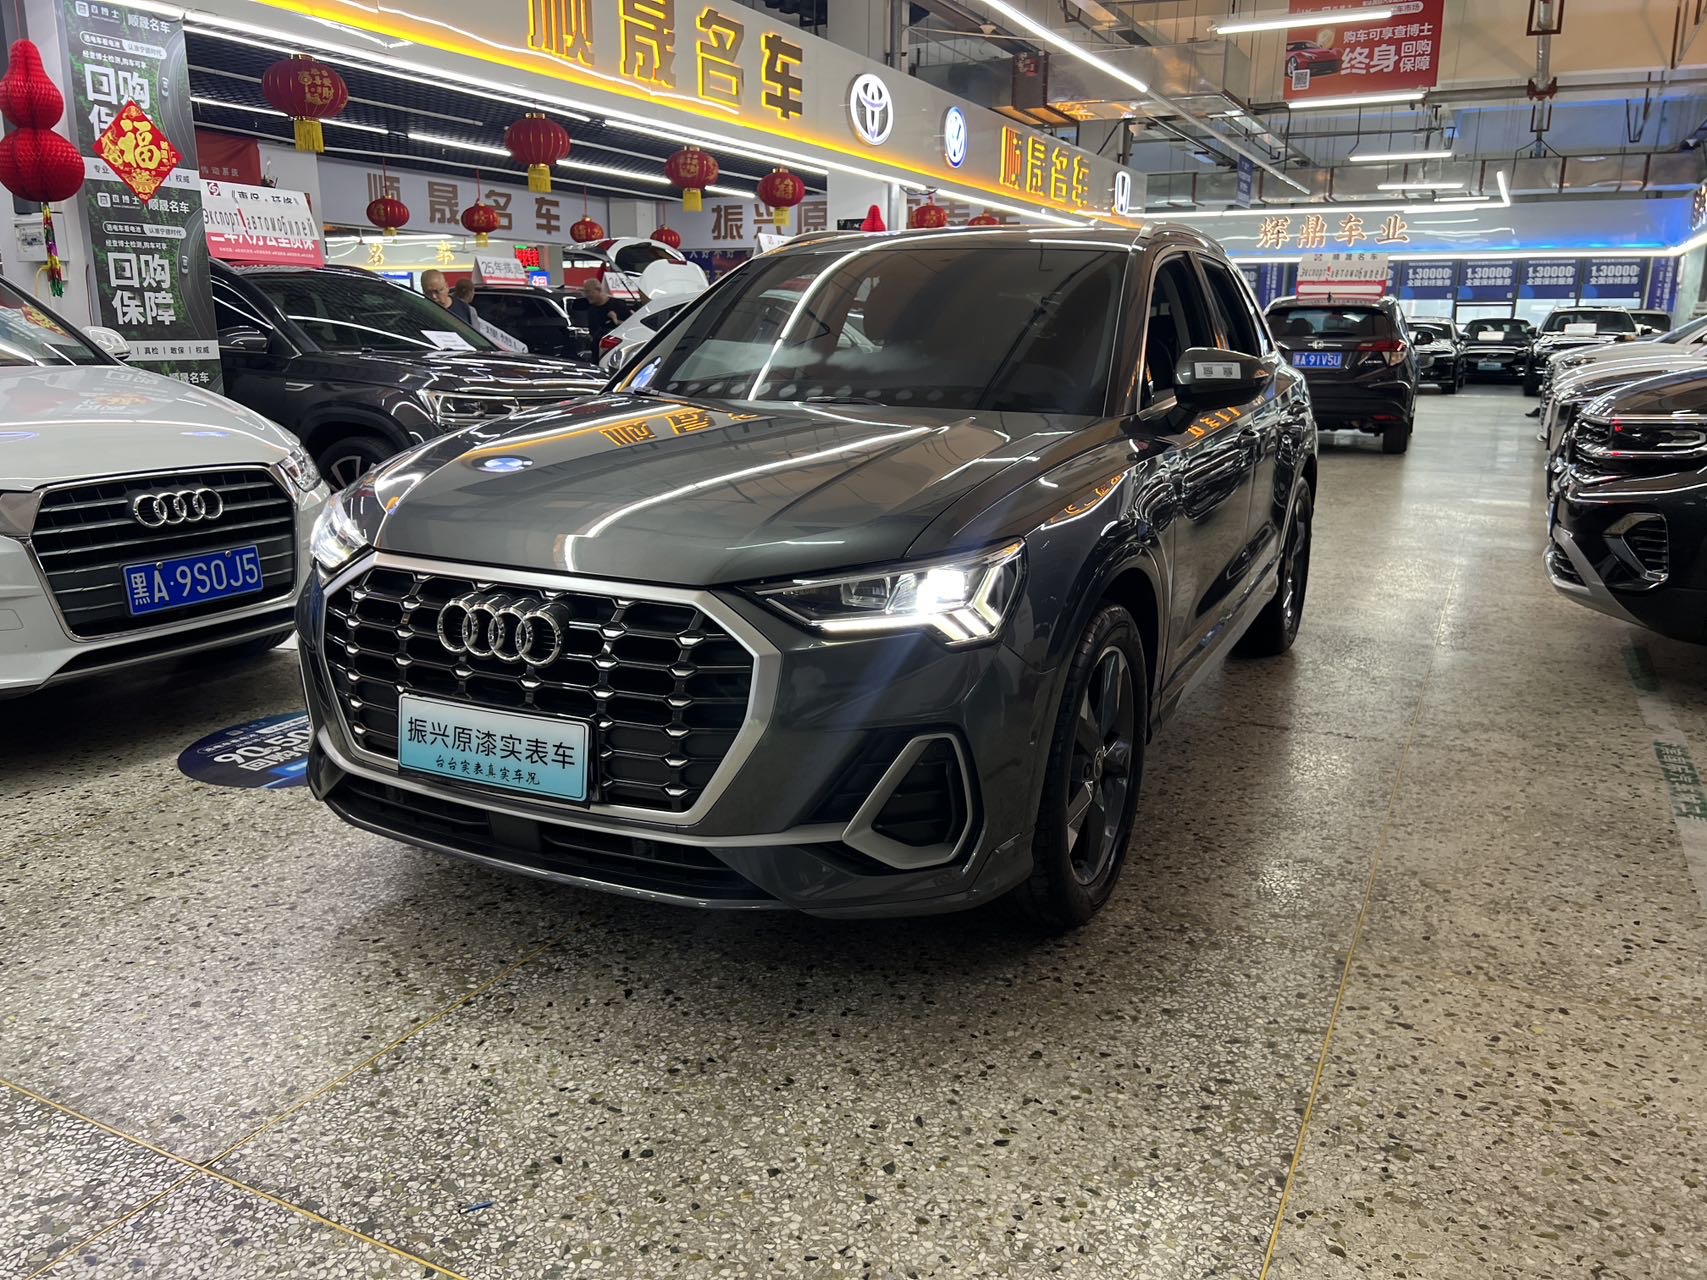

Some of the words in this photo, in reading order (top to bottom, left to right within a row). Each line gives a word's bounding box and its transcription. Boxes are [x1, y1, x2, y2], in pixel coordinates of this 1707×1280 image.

[1344, 22, 1434, 44] 购车可享查博士
[1401, 39, 1432, 56] 回购
[527, 0, 803, 120] 顺晟名车
[1340, 43, 1399, 75] 终身
[1400, 56, 1431, 72] 保障
[84, 63, 151, 110] 回购
[117, 119, 161, 170] 福
[1256, 213, 1410, 249] 辉鼎车业
[107, 252, 171, 289] 回购
[111, 290, 176, 325] 保障
[407, 716, 576, 770] 振兴原漆实表车
[434, 754, 541, 786] 台台实表真实车况
